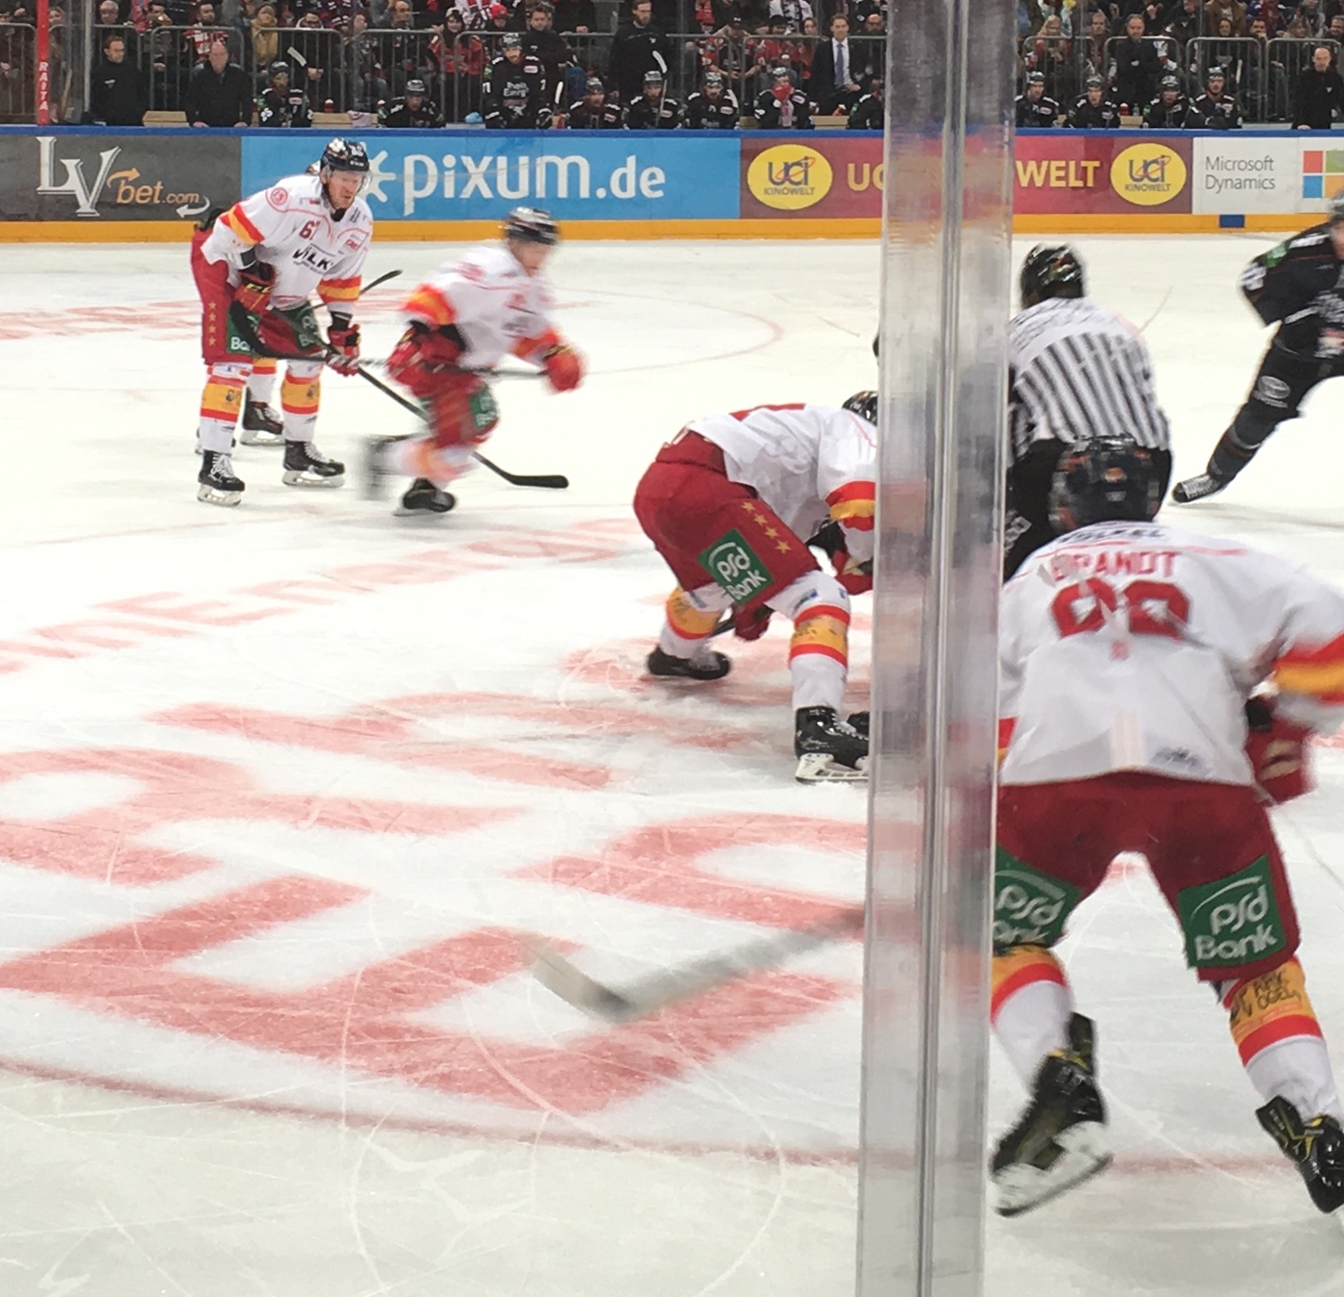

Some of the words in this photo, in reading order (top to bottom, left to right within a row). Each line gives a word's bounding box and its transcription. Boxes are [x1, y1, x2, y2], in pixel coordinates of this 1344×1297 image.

[37, 61, 49, 111] RAITA
[35, 135, 122, 218] LV
[1014, 159, 1101, 188] WELT
[1205, 155, 1275, 172] Microsoft
[402, 151, 667, 217] pixum.de
[763, 186, 816, 197] KINOWELT
[1124, 183, 1172, 193] KINOWELT
[1205, 174, 1276, 194] Dynamics
[725, 568, 767, 601] Bank
[1208, 883, 1270, 936] psd
[1193, 923, 1279, 963] Bank
